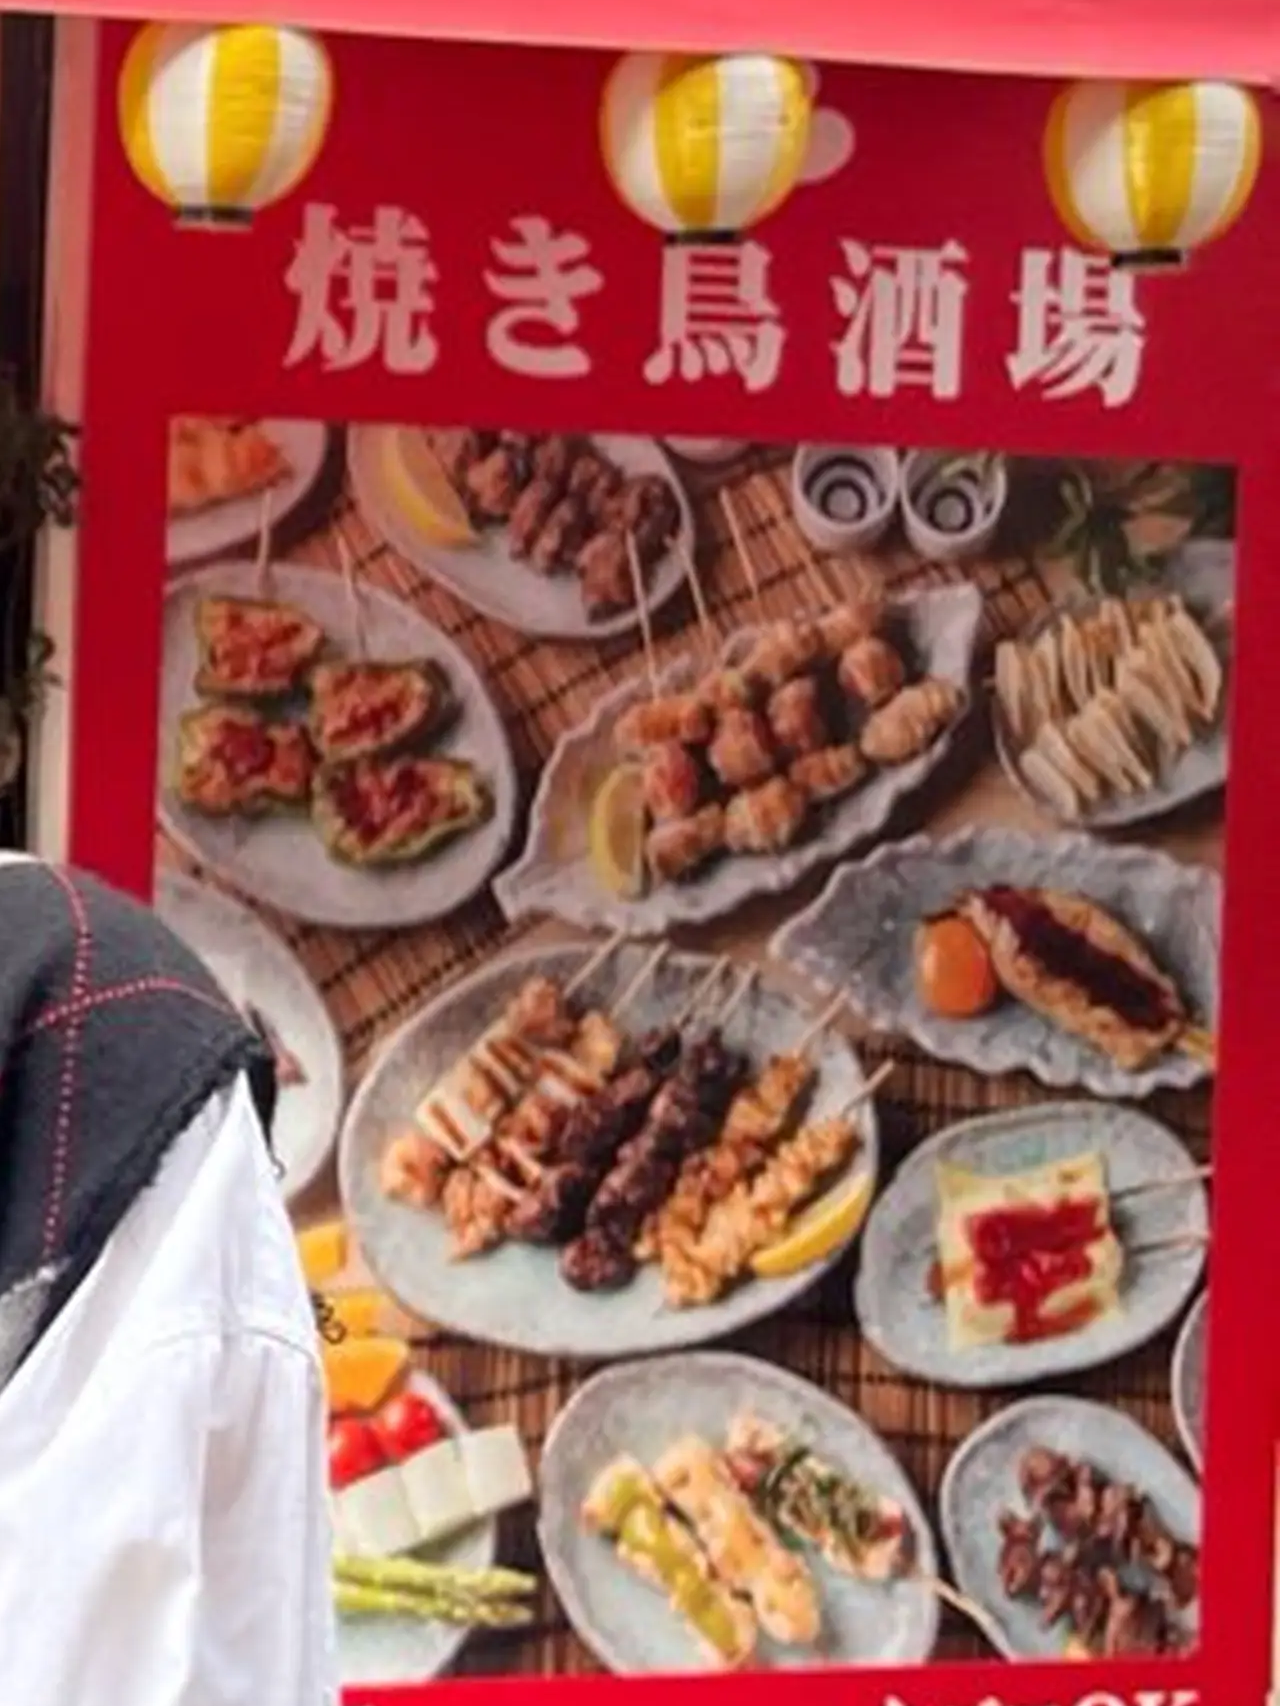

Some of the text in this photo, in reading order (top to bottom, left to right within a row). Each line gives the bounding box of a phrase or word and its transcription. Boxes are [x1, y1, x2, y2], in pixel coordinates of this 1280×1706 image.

[282, 204, 1146, 408] 焼き鳥酒場
